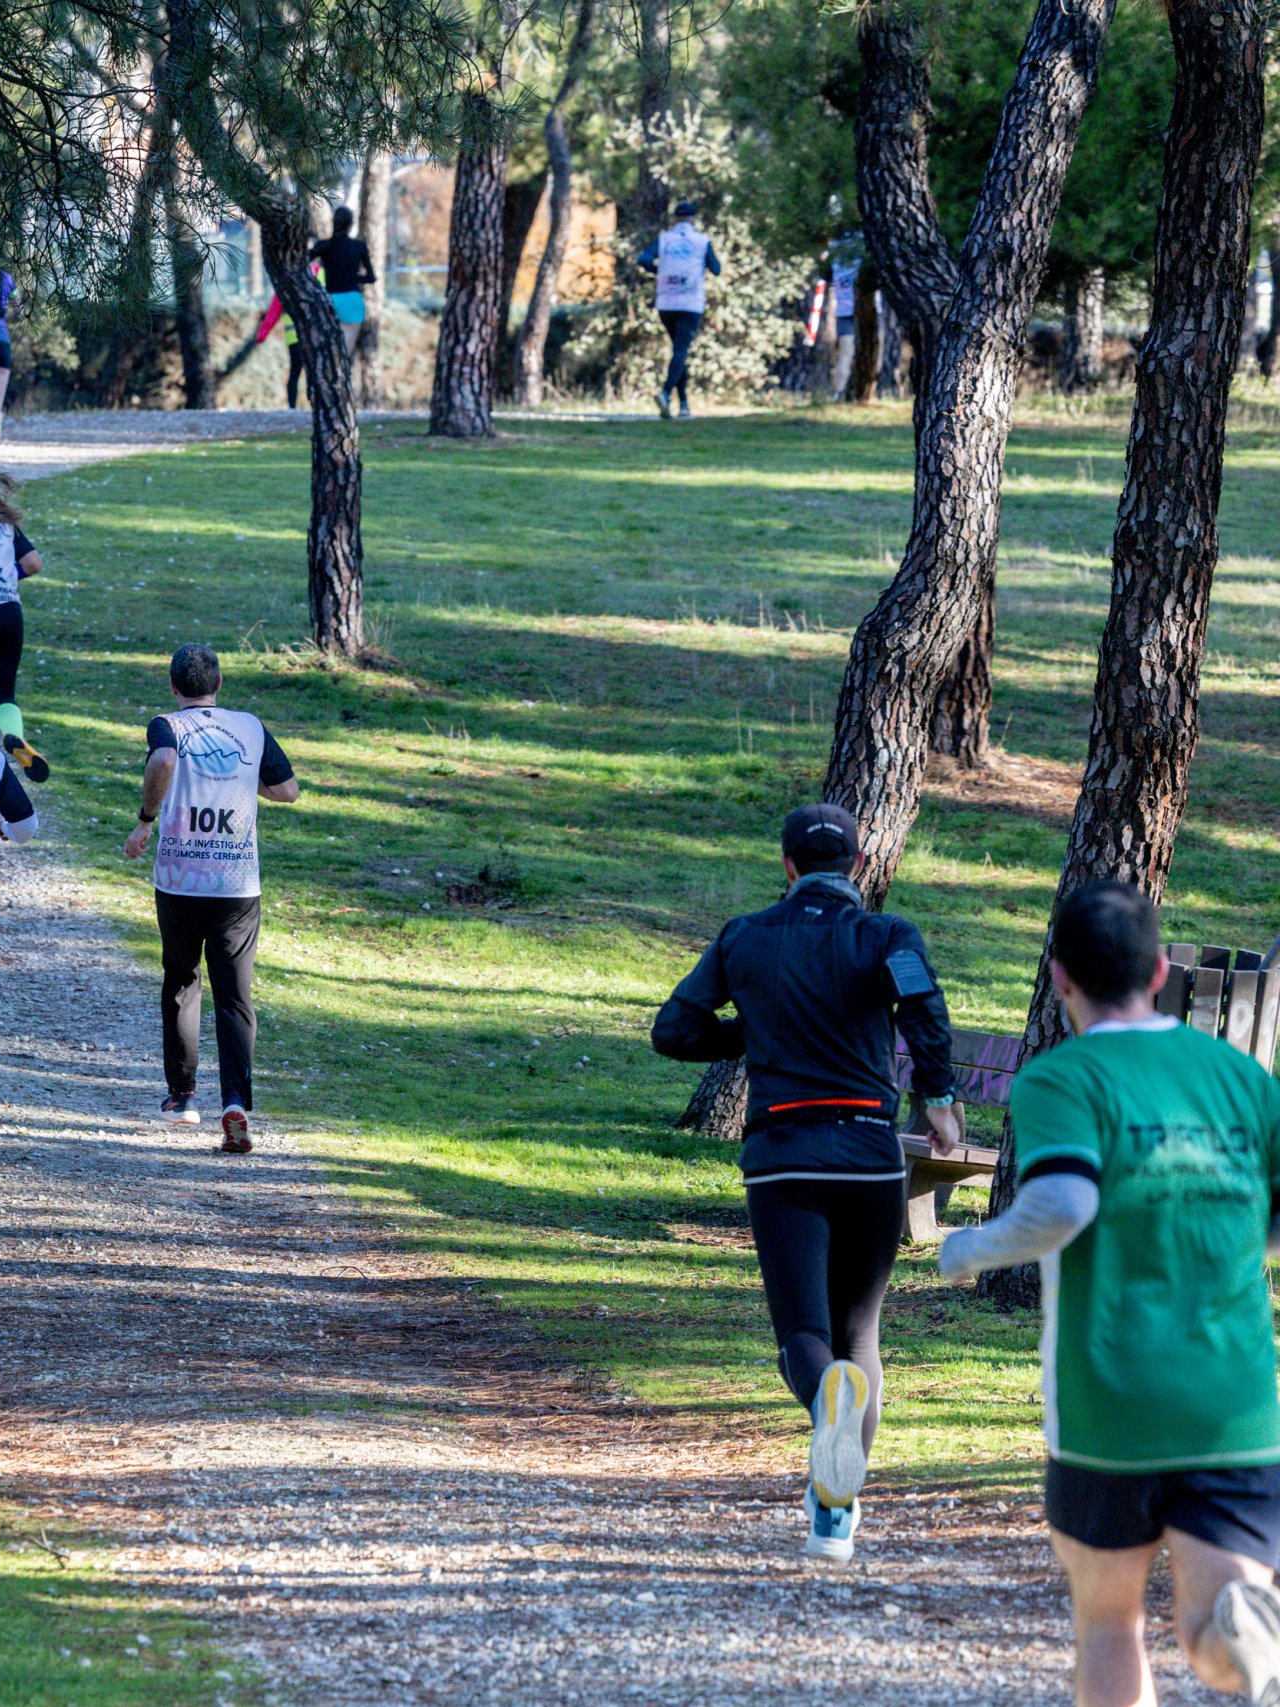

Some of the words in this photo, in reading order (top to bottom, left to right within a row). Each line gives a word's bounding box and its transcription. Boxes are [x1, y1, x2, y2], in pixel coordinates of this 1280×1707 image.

[189, 806, 235, 835] 10K
[179, 838, 192, 847] LA
[161, 848, 171, 856] DE
